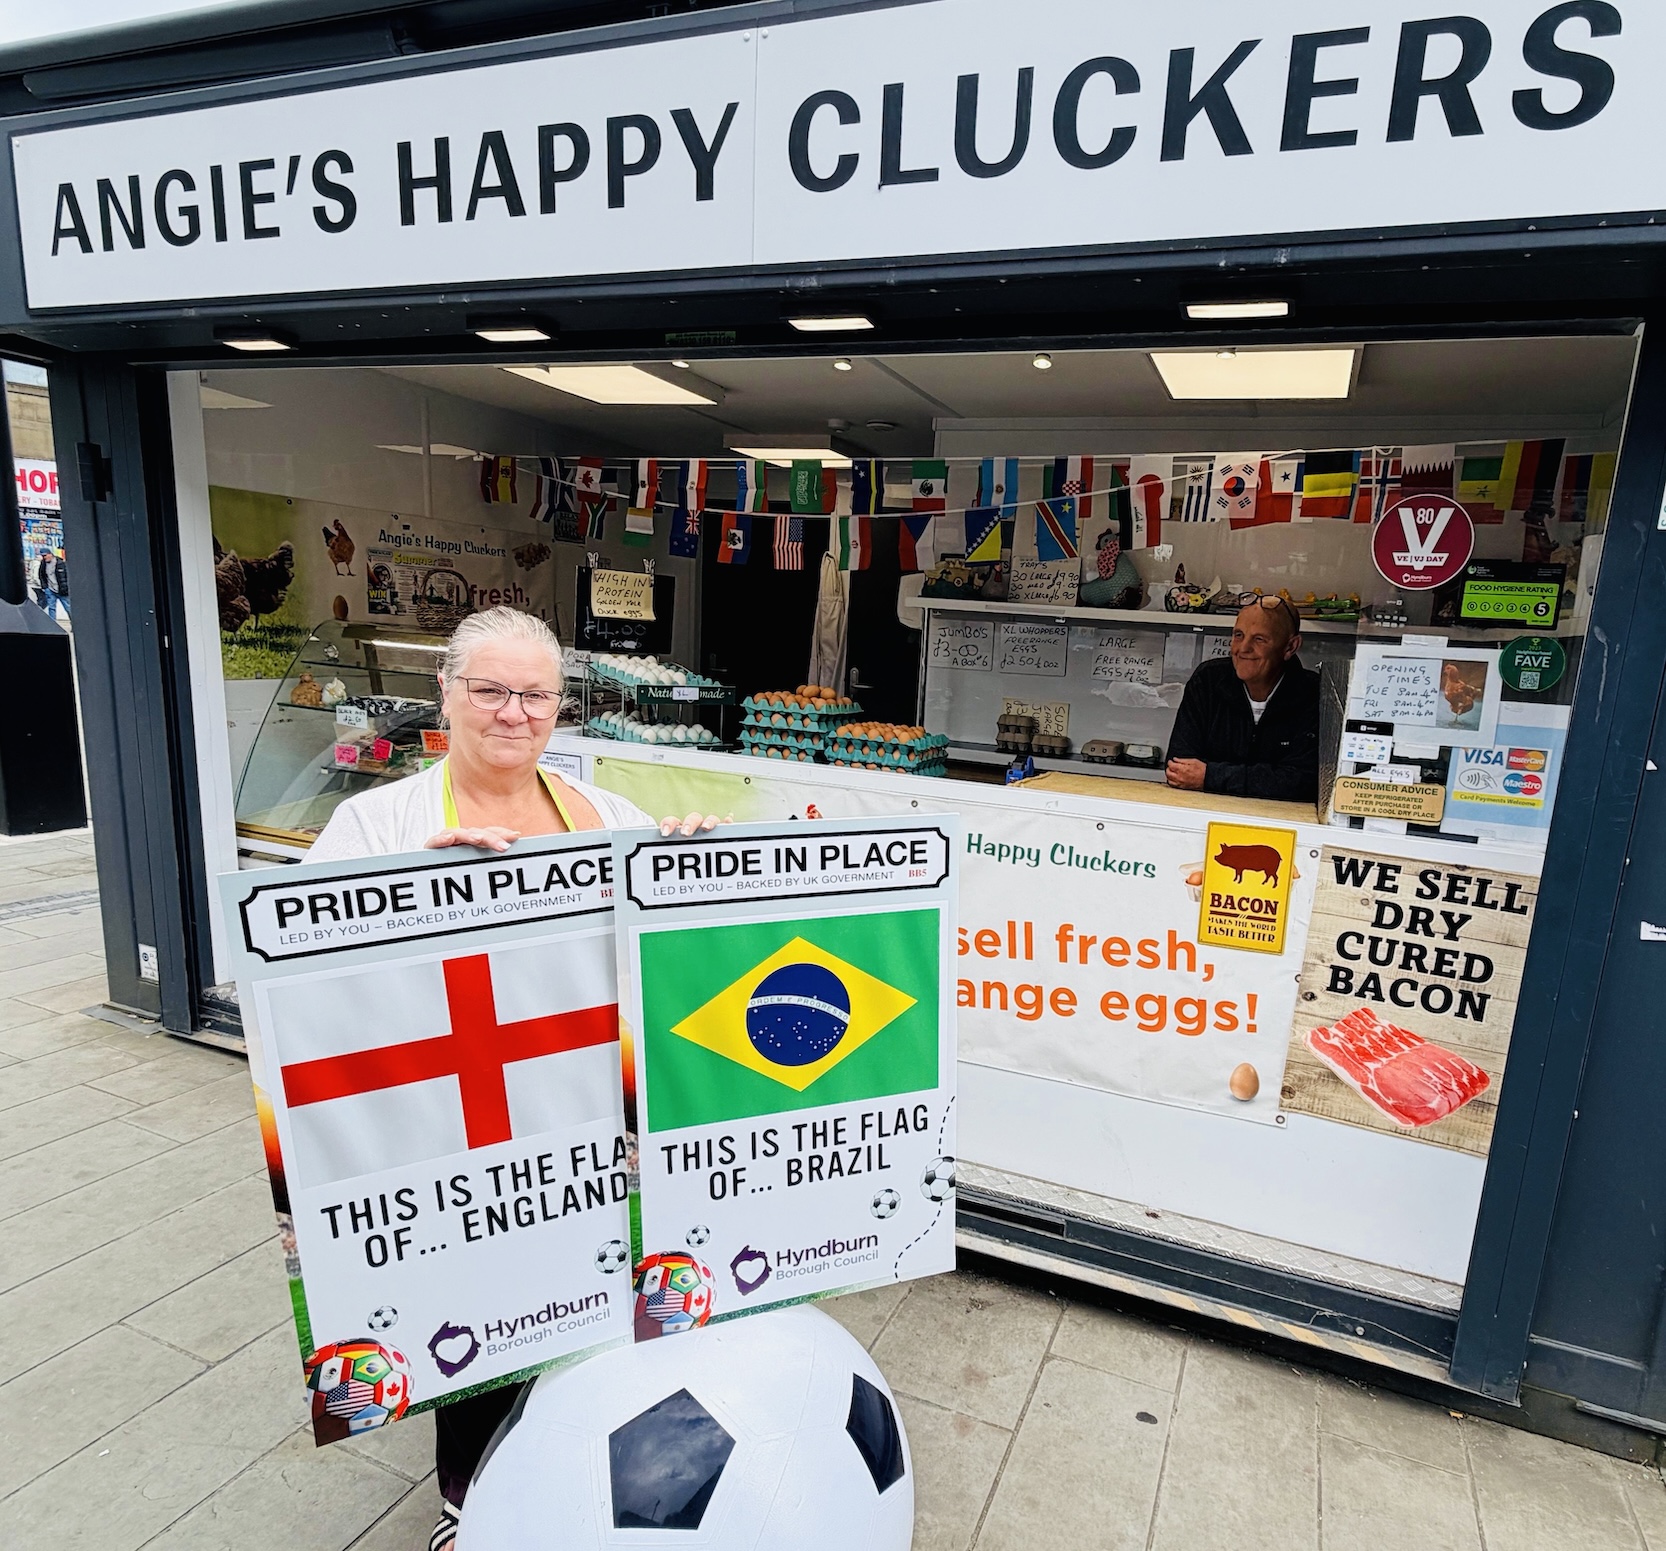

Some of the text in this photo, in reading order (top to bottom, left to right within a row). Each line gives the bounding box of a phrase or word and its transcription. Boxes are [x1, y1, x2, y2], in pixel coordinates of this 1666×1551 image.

[51, 0, 1623, 257] ANGIE'S HAPPY CLUCKERS
[1416, 507, 1435, 525] 80
[378, 529, 507, 558] Angie's Happy Cluckers
[393, 552, 438, 566] Summer
[597, 573, 648, 588] HIGH IN
[1011, 569, 1028, 582] 30
[470, 582, 530, 607] fresh,
[596, 586, 644, 598] PROTEIN
[1469, 584, 1554, 594] FOOD HYGIENE RATING
[596, 597, 622, 606] GOLDEN
[1536, 603, 1547, 616] 5
[937, 626, 989, 639] JUMBO'S
[1003, 626, 1067, 636] XL WHOPPERS
[1098, 637, 1137, 649] LARGE
[952, 656, 988, 667] A BOX 6
[1095, 654, 1155, 667] FREE RANGE
[1514, 655, 1552, 668] FAVE
[1371, 664, 1427, 675] OPENING
[1365, 684, 1389, 696] TUE
[1363, 699, 1379, 708] FRI
[1364, 710, 1384, 718] SAT
[550, 761, 576, 769] CLUCKERS
[1463, 749, 1545, 766] VISA MasterCard
[1371, 767, 1386, 775] ALL
[1342, 780, 1439, 796] CONSUMER ADVICE
[1503, 779, 1542, 790] Maestro
[1373, 793, 1424, 804] REFRIGERATED
[1375, 800, 1411, 809] PURCHASE
[1459, 793, 1536, 807] Card Payments Welcome
[1412, 811, 1436, 819] PLACE
[652, 839, 928, 882] PRIDE IN PLACE
[966, 832, 1157, 879] Happy Cluckers
[908, 868, 928, 879] BB5
[652, 870, 895, 897] LED BY YOU BACKED BY UK GOVERNMENT
[1331, 855, 1529, 916] WE SELL
[273, 881, 420, 929] PRIDE
[429, 874, 474, 907] IN
[1209, 892, 1279, 916] BACON
[279, 891, 583, 946] LED BY YOU BACKED BY UK GOVERNMENT
[1208, 916, 1277, 932] MAKES THE WORLD
[1370, 899, 1472, 942] DRY
[1207, 925, 1276, 944] TASTE BETTER
[957, 920, 1215, 983] sell fresh,
[1336, 931, 1495, 984] CURED
[1326, 964, 1492, 1023] BACON
[750, 996, 783, 1006] ORDEM
[796, 997, 850, 1021] PROGRESSO
[1100, 990, 1259, 1037] eggs!
[660, 1103, 930, 1175] THIS IS THE FLAG
[709, 1142, 891, 1201] OF... BRAZIL
[320, 1134, 627, 1239] THIS IS THE FLA
[364, 1171, 629, 1269] OF... ENGLAND
[775, 1233, 879, 1268] Hyndburn
[775, 1249, 879, 1281] Borough Council
[484, 1290, 609, 1342] Hyndburn
[486, 1307, 611, 1356] Borough Council
